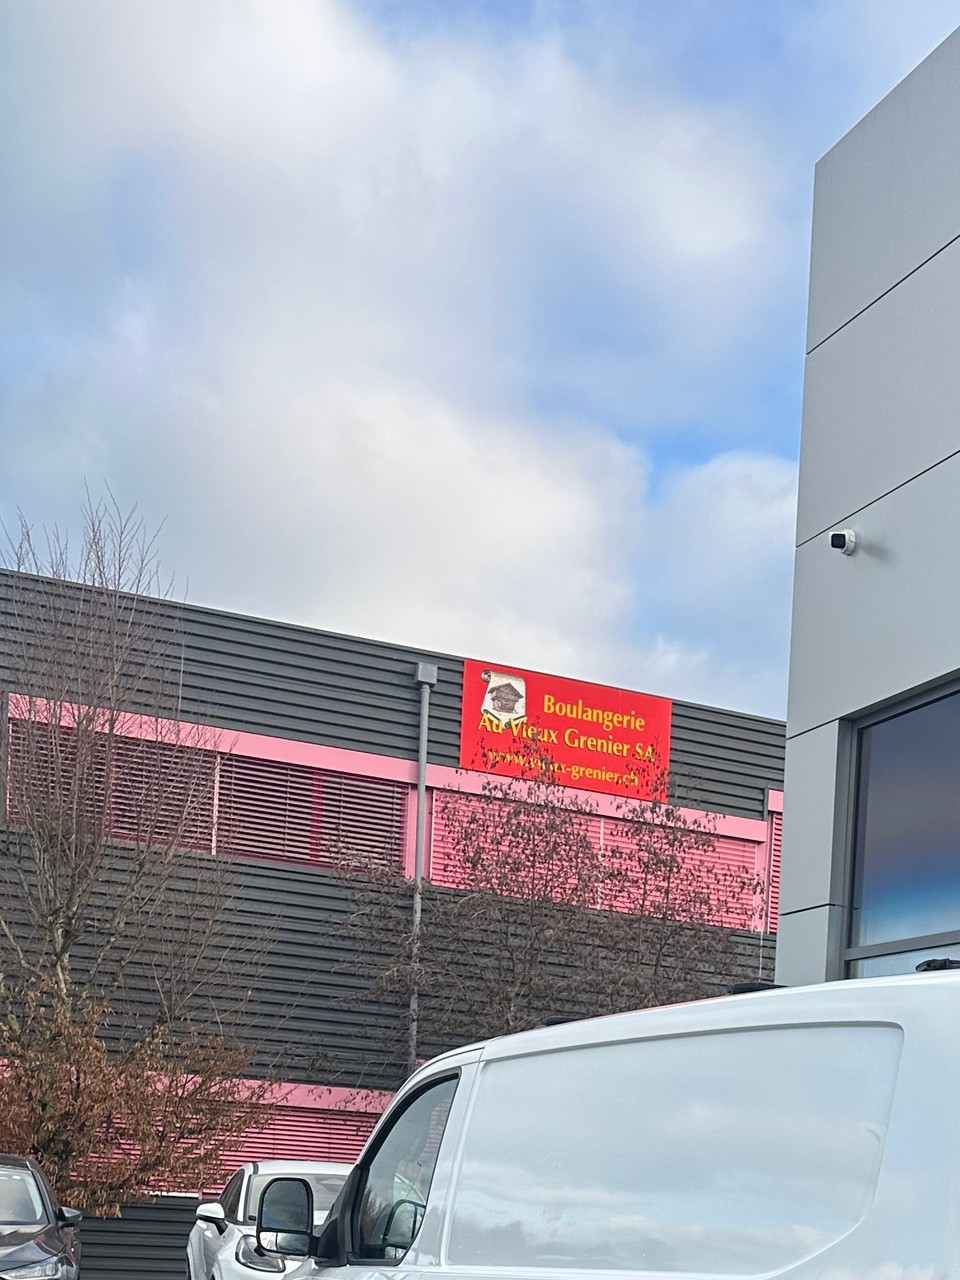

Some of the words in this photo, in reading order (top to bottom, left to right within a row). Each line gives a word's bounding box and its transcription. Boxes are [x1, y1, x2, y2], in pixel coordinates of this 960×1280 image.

[543, 694, 646, 731] Boulangerie
[478, 712, 503, 734] Au
[509, 716, 559, 744] Vieux
[563, 728, 631, 757] Grenier
[635, 742, 656, 763] SA
[488, 750, 639, 787] www.viux-grenier.ch
